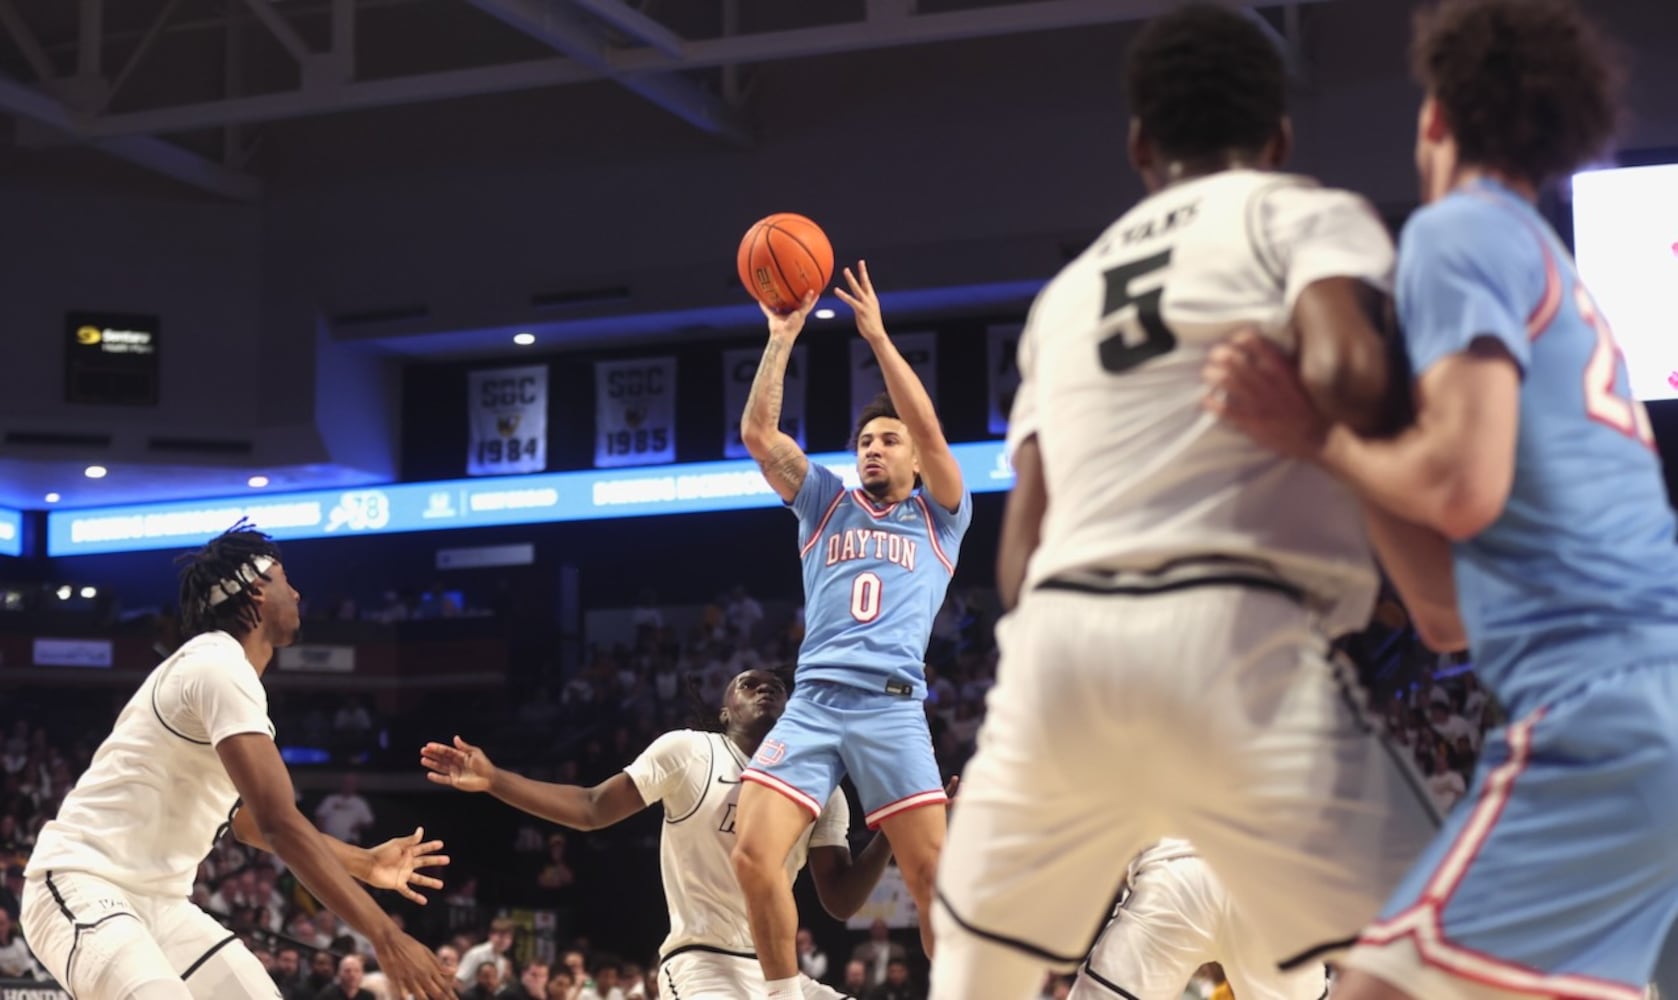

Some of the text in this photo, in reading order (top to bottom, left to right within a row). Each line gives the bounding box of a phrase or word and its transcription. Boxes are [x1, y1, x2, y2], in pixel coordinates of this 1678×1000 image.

[1096, 247, 1177, 375] 5
[478, 438, 537, 466] 1984
[606, 427, 668, 457] 1985
[826, 527, 917, 573] DAYTON
[849, 570, 882, 624] 0
